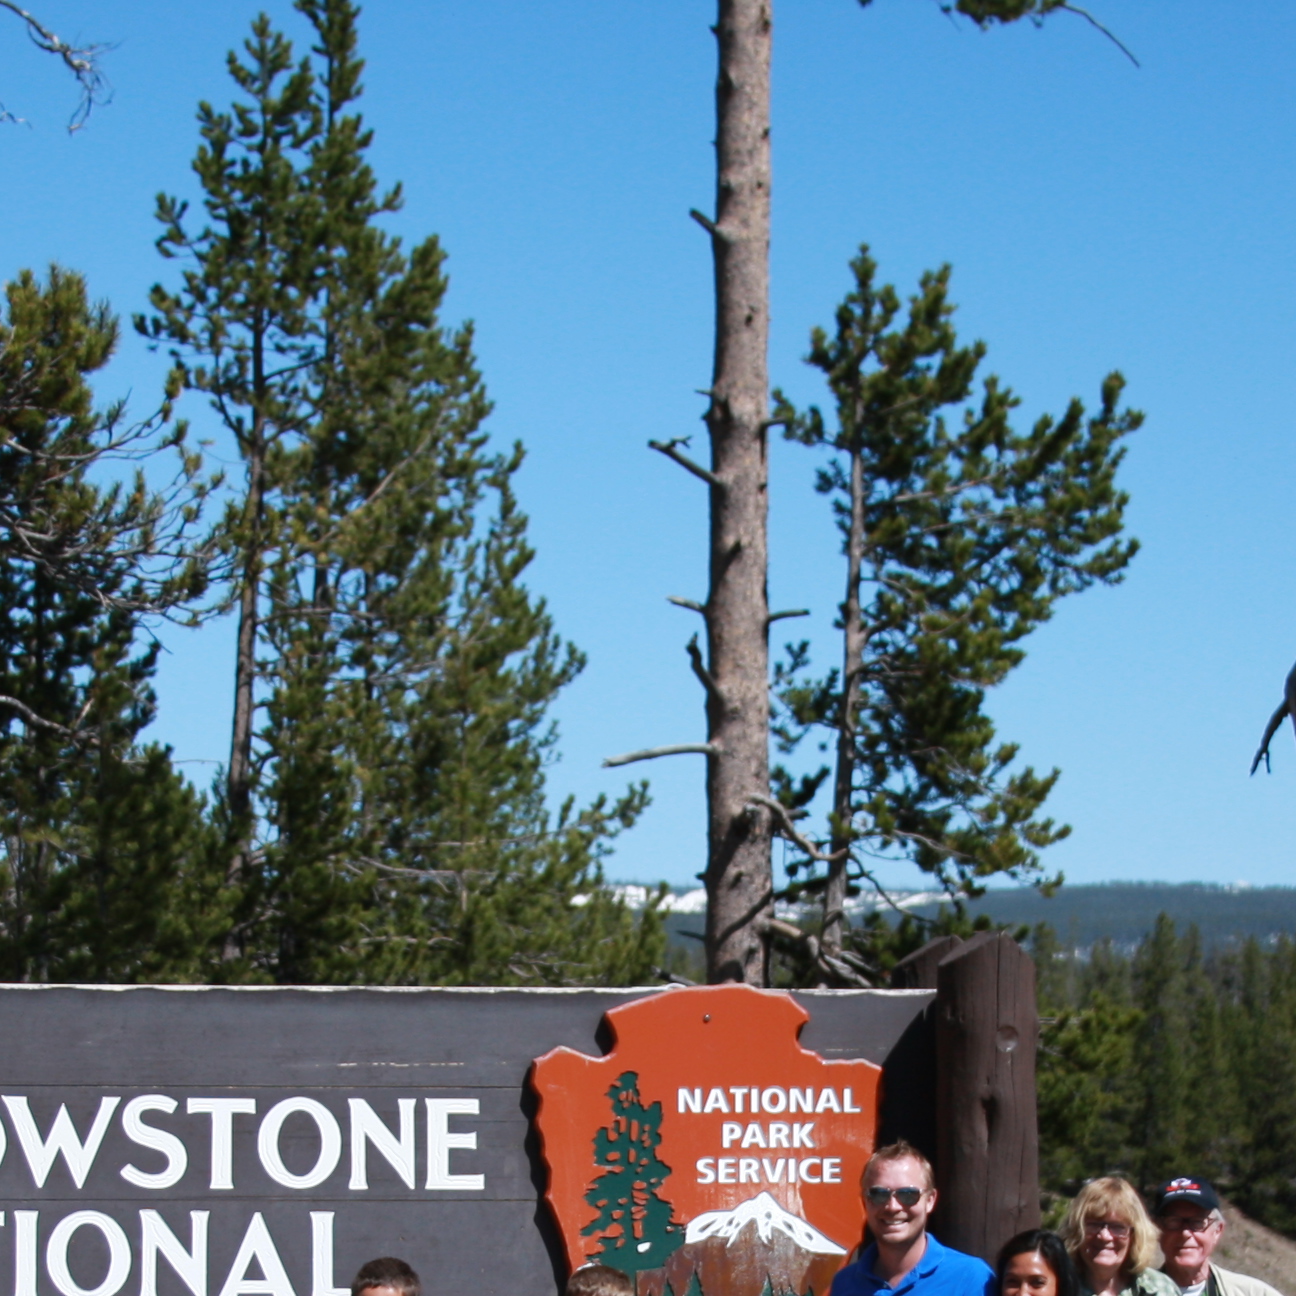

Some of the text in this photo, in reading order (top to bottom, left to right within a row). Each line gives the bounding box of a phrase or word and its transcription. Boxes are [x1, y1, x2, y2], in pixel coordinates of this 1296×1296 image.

[678, 1087, 861, 1113] NATIONAL
[723, 1122, 815, 1148] PARK
[696, 1157, 841, 1184] SERVICE
